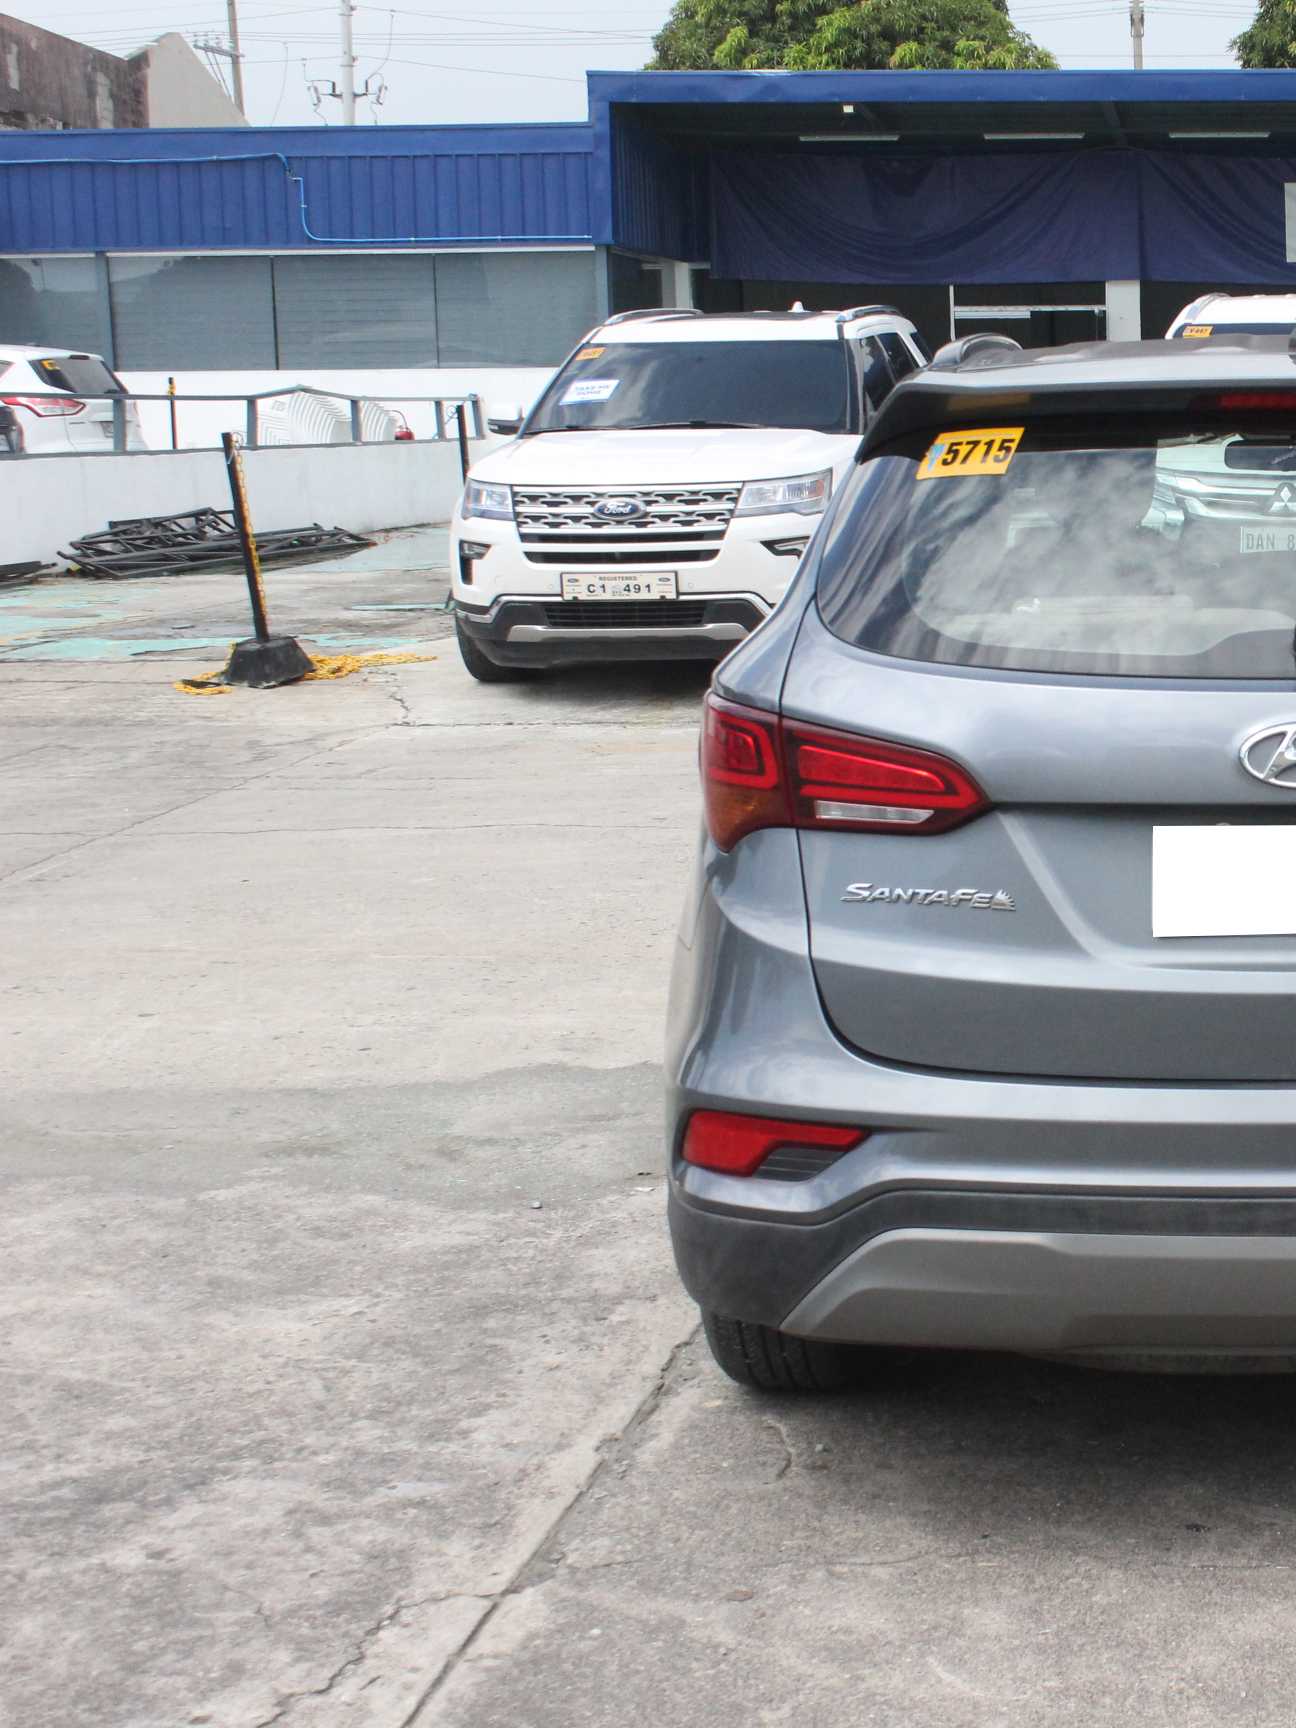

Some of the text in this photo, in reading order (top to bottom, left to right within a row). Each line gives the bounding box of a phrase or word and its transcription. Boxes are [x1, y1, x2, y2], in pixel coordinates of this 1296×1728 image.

[603, 502, 632, 514] Ford
[1245, 533, 1276, 551] DAN
[623, 583, 653, 594] 491
